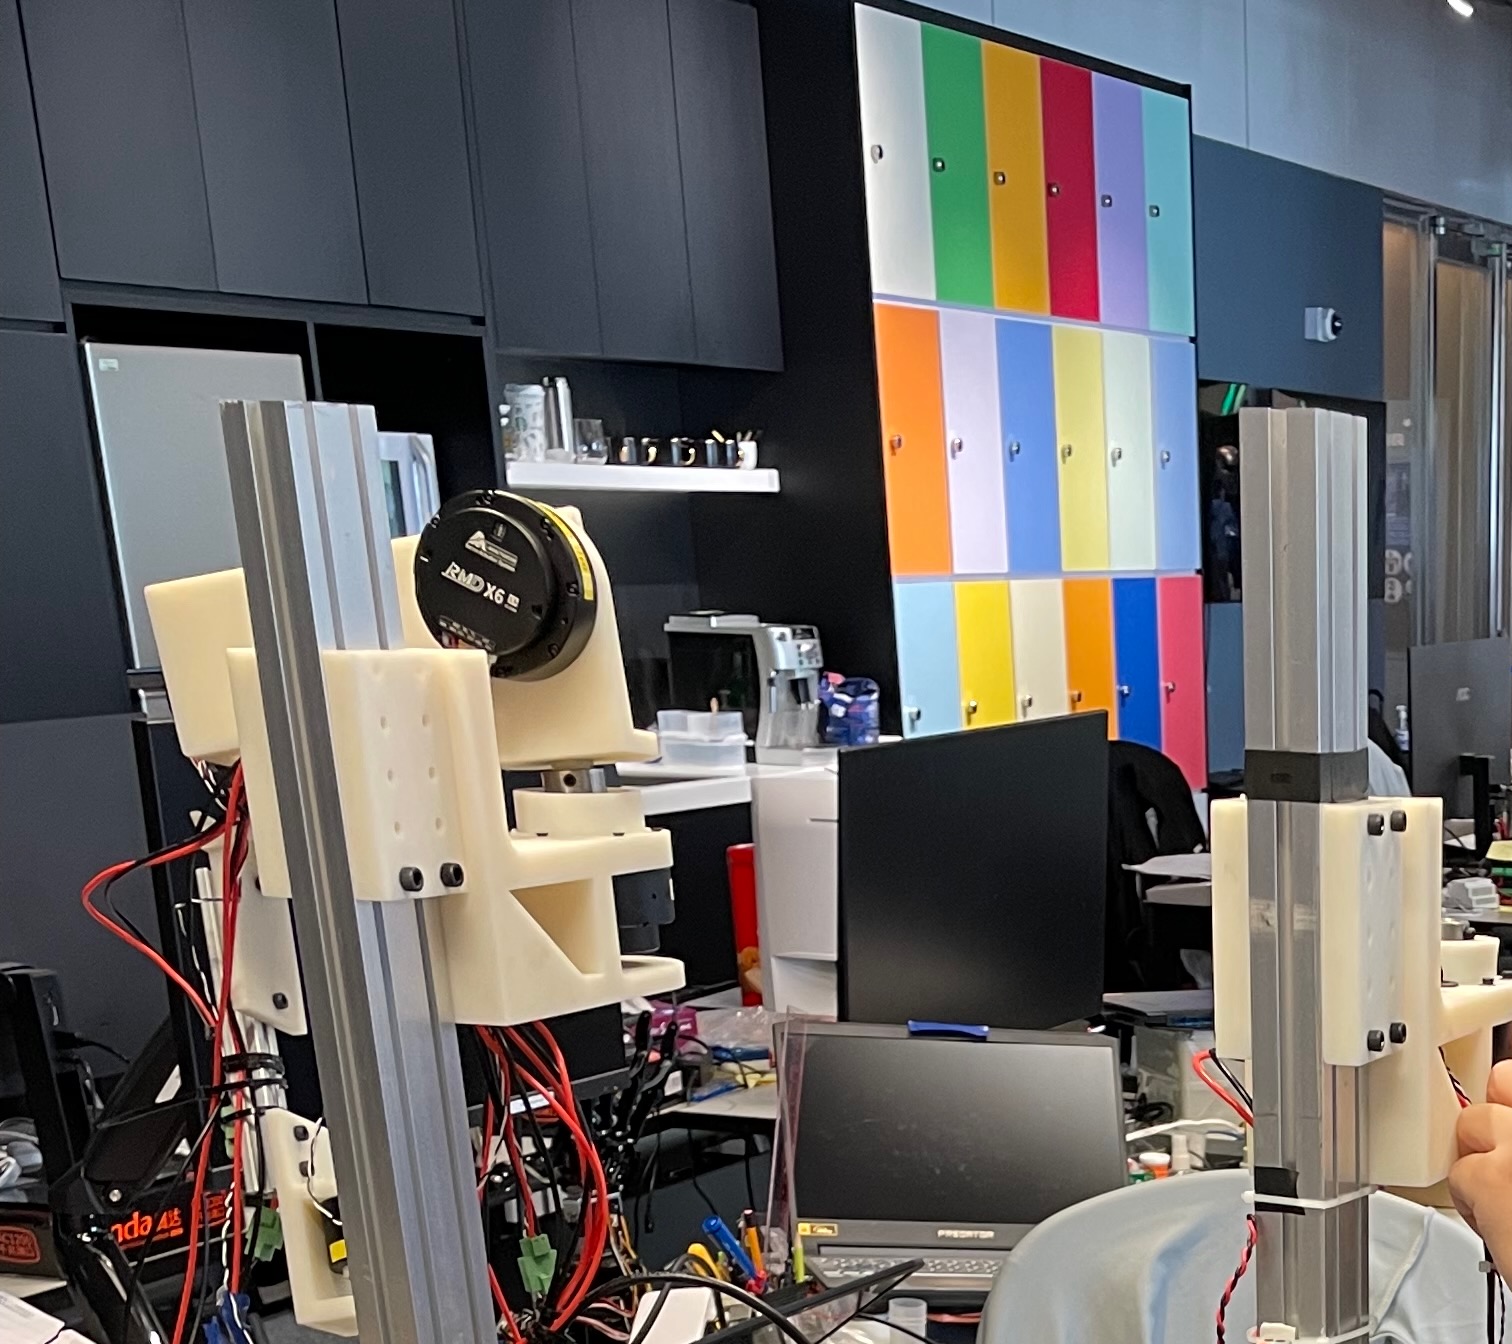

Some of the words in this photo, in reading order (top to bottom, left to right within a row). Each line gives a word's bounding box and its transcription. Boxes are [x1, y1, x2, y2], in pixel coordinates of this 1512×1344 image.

[441, 561, 485, 593] RMD
[483, 582, 506, 605] X6
[110, 1210, 153, 1244] nda
[937, 1229, 995, 1239] PREDATOR
